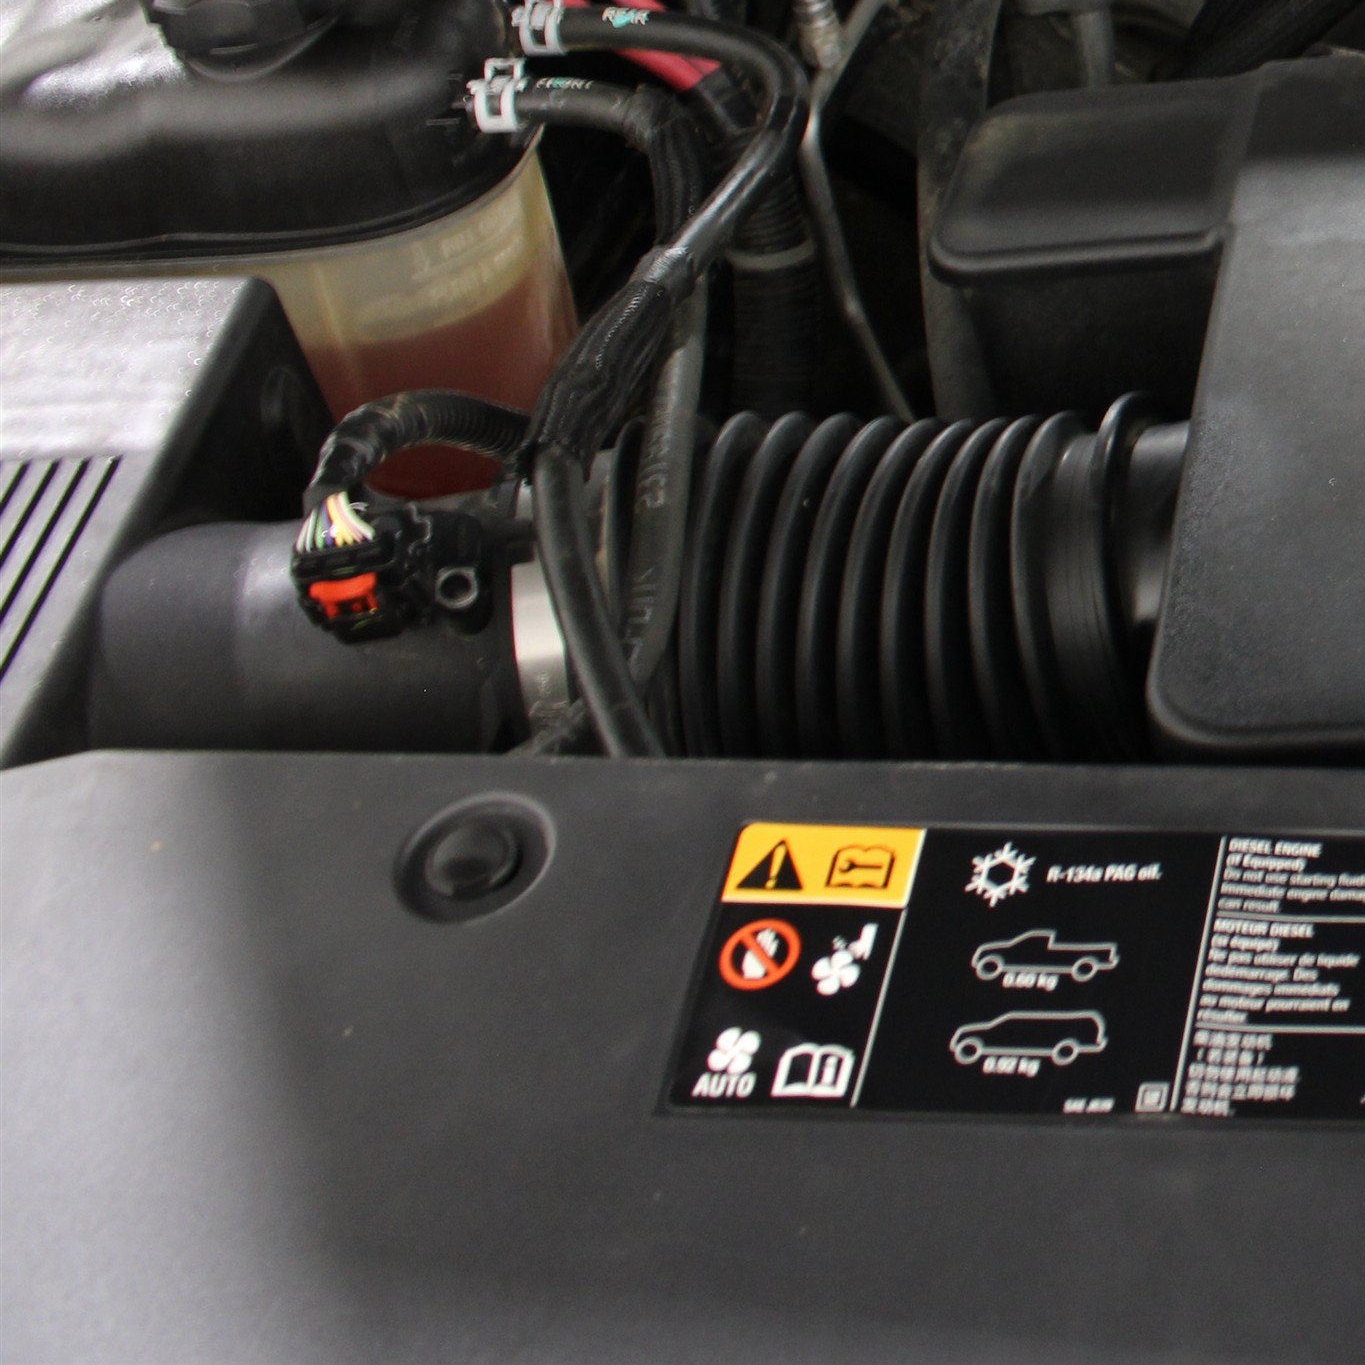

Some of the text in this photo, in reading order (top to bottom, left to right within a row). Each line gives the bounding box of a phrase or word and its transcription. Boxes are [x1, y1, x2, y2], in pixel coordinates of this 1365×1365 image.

[1229, 838, 1323, 858] DIESEL ENGINE
[1047, 864, 1103, 883] R-134a
[1104, 863, 1138, 882] PAG
[1214, 918, 1314, 938] MOTEUR DIESEL
[692, 1072, 756, 1098] AUTO
